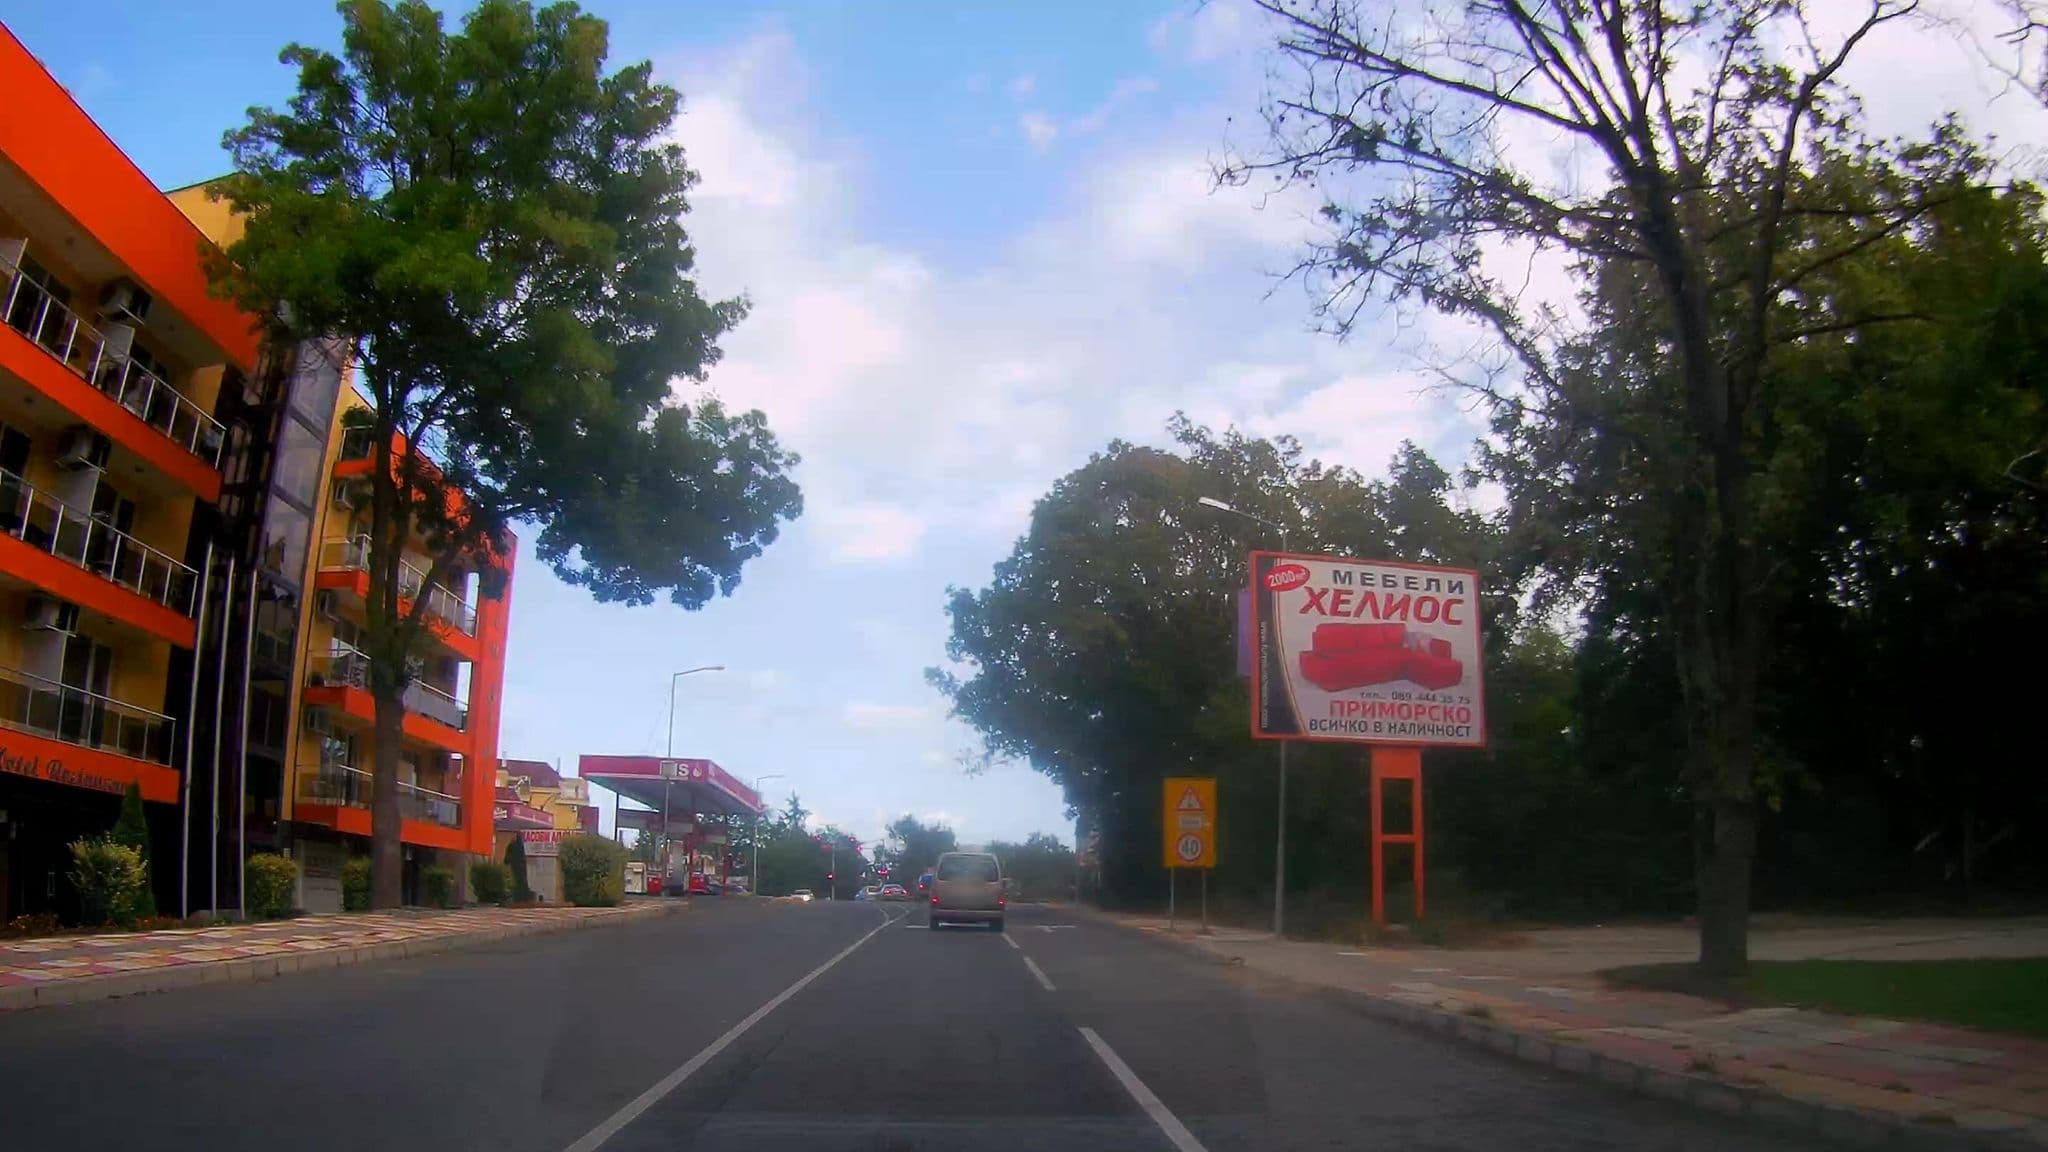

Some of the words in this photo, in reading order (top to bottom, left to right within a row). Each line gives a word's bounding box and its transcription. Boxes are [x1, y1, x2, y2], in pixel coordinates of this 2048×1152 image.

[1332, 569, 1464, 595] МЕБЕЛИ
[1299, 586, 1465, 625] ХЕЛИОС
[1329, 700, 1471, 724] ПРИМОРСКО
[1309, 719, 1368, 733] ВСИЧКО
[1373, 721, 1382, 733] В
[1388, 721, 1472, 737] НАЛИЧНОСТ
[47, 759, 128, 795] Restauran
[1182, 839, 1199, 855] 40
